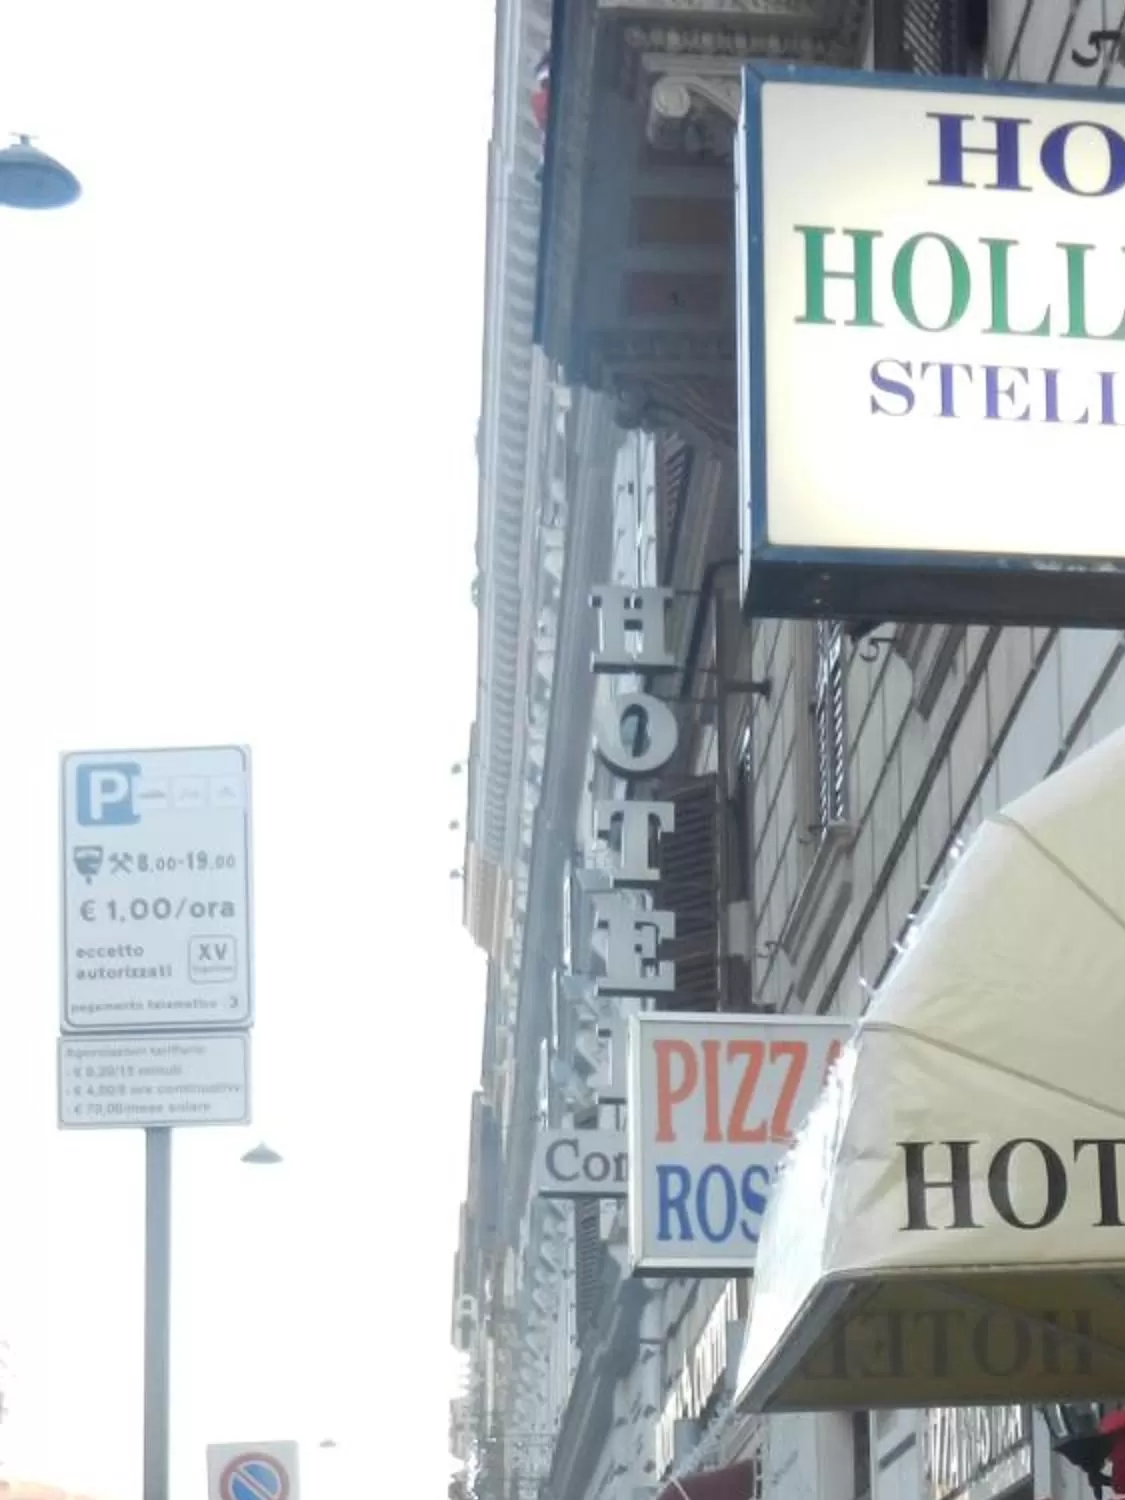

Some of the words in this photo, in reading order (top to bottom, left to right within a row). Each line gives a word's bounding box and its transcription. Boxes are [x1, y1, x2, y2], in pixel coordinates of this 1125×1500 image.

[75, 944, 145, 959] eccetto
[75, 964, 173, 980] autorizzati
[655, 1163, 783, 1243] ROS
